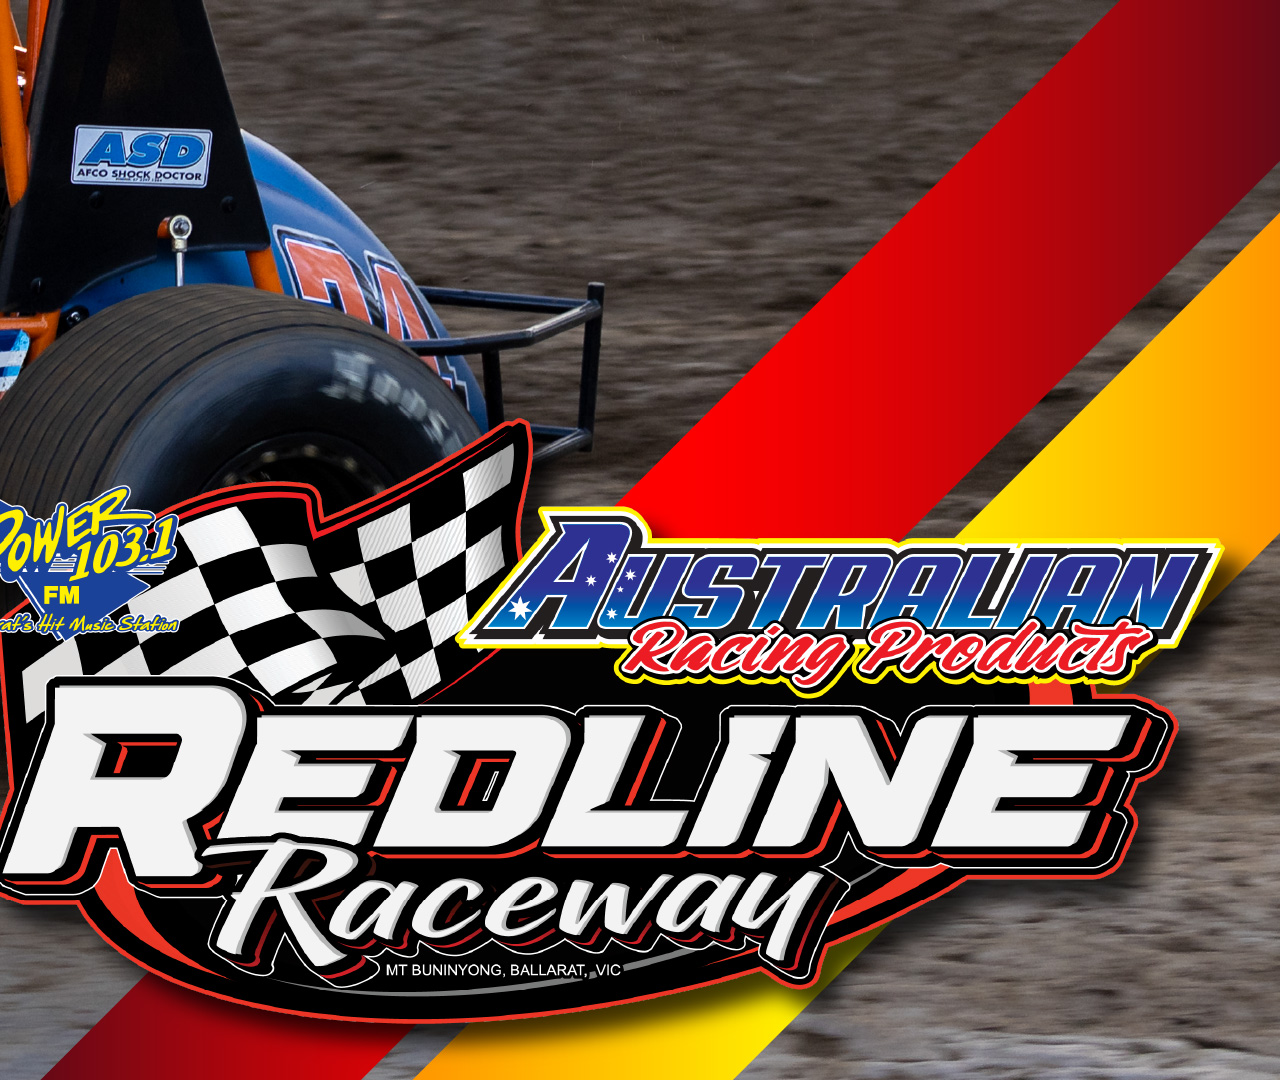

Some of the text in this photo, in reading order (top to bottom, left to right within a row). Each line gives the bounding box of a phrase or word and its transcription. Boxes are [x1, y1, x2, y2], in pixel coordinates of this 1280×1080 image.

[78, 130, 206, 169] ASD
[77, 168, 108, 178] AFCO
[111, 169, 151, 179] SHOCK
[155, 171, 202, 181] DOCTOR
